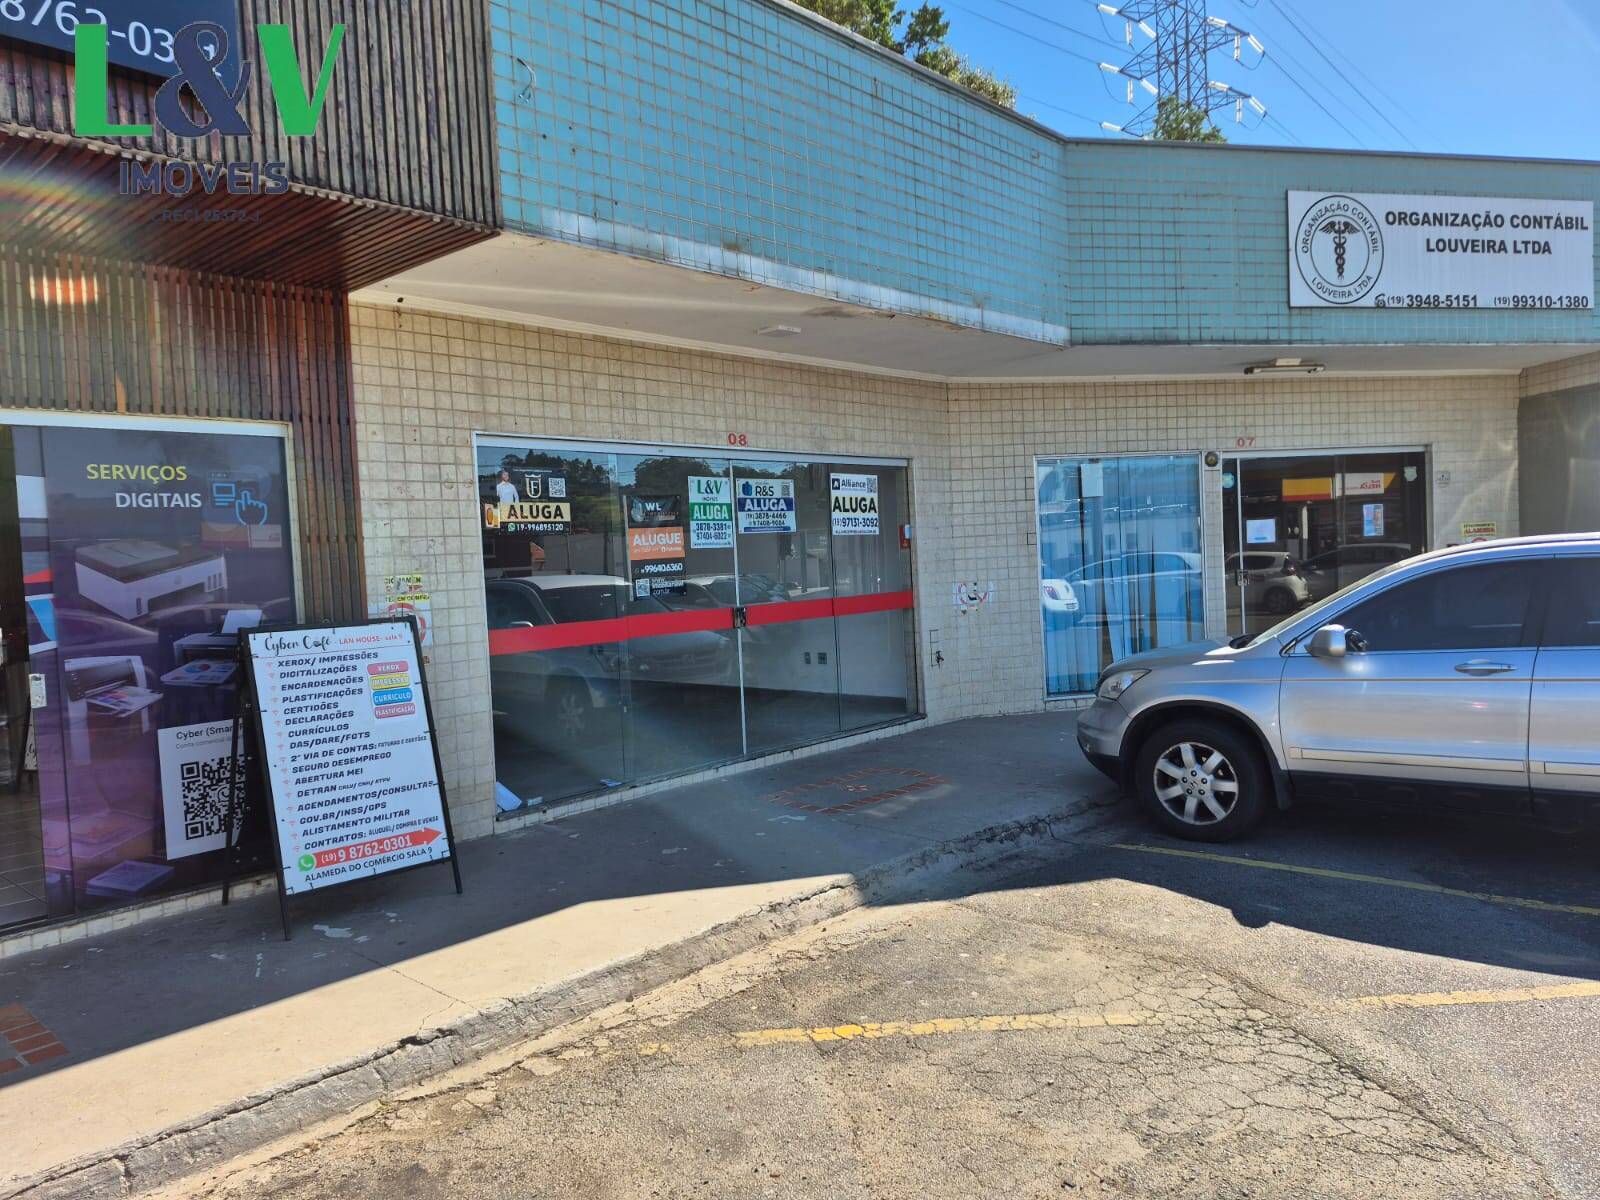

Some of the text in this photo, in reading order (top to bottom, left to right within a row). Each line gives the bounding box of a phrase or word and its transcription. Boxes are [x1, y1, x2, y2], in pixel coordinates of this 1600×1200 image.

[1302, 202, 1350, 254] ORGANIZAÇÃO
[1385, 211, 1589, 231] ORGANIZAÇÃO CONTÁBIL
[1426, 238, 1552, 256] LOUVEIRA LTDA
[1311, 274, 1374, 299] LOUVEIRA LTDA
[1387, 294, 1589, 308] (19) 3948-5151 (19) 99310-1380
[728, 433, 748, 446] 08
[1236, 437, 1257, 448] 07
[86, 464, 188, 484] SERVIÇOS
[697, 479, 722, 495] L&V
[755, 485, 775, 497] R&S
[115, 492, 202, 508] DIGITAIS
[744, 498, 788, 511] ALUGA
[832, 496, 878, 514] ALUGA
[507, 504, 564, 519] ALUGA
[693, 504, 729, 520] ALUGA
[633, 532, 682, 546] ALUGUE
[265, 637, 300, 657] Cyber
[278, 651, 379, 667] XEROX/ IMPRESSÕES
[280, 664, 358, 679] DIGITALIZAÇÕES
[282, 687, 363, 703] PLASTIFICAÇÕES
[284, 702, 339, 714] CERTIDÕES
[285, 710, 354, 725] DECLARAÇÕES
[176, 730, 203, 740] Cyber
[288, 724, 349, 737] CURRÍCULOS
[290, 731, 370, 749] DAS/DARE/FGTS
[304, 752, 319, 760] VIA
[337, 743, 377, 754] CONTAS:
[292, 752, 391, 773] SEGURO DESEMPREGO
[295, 768, 363, 785] ABERTURA MEI
[297, 785, 337, 797] DETRAN
[302, 809, 410, 836] ALISTAMENTO MILITAR
[321, 835, 413, 864] (19) 9 8762-0301
[305, 867, 347, 882] ALAMEDA
[349, 862, 362, 872] DO
[363, 854, 405, 868] COMÉRCIO
[407, 849, 426, 859] SALA
